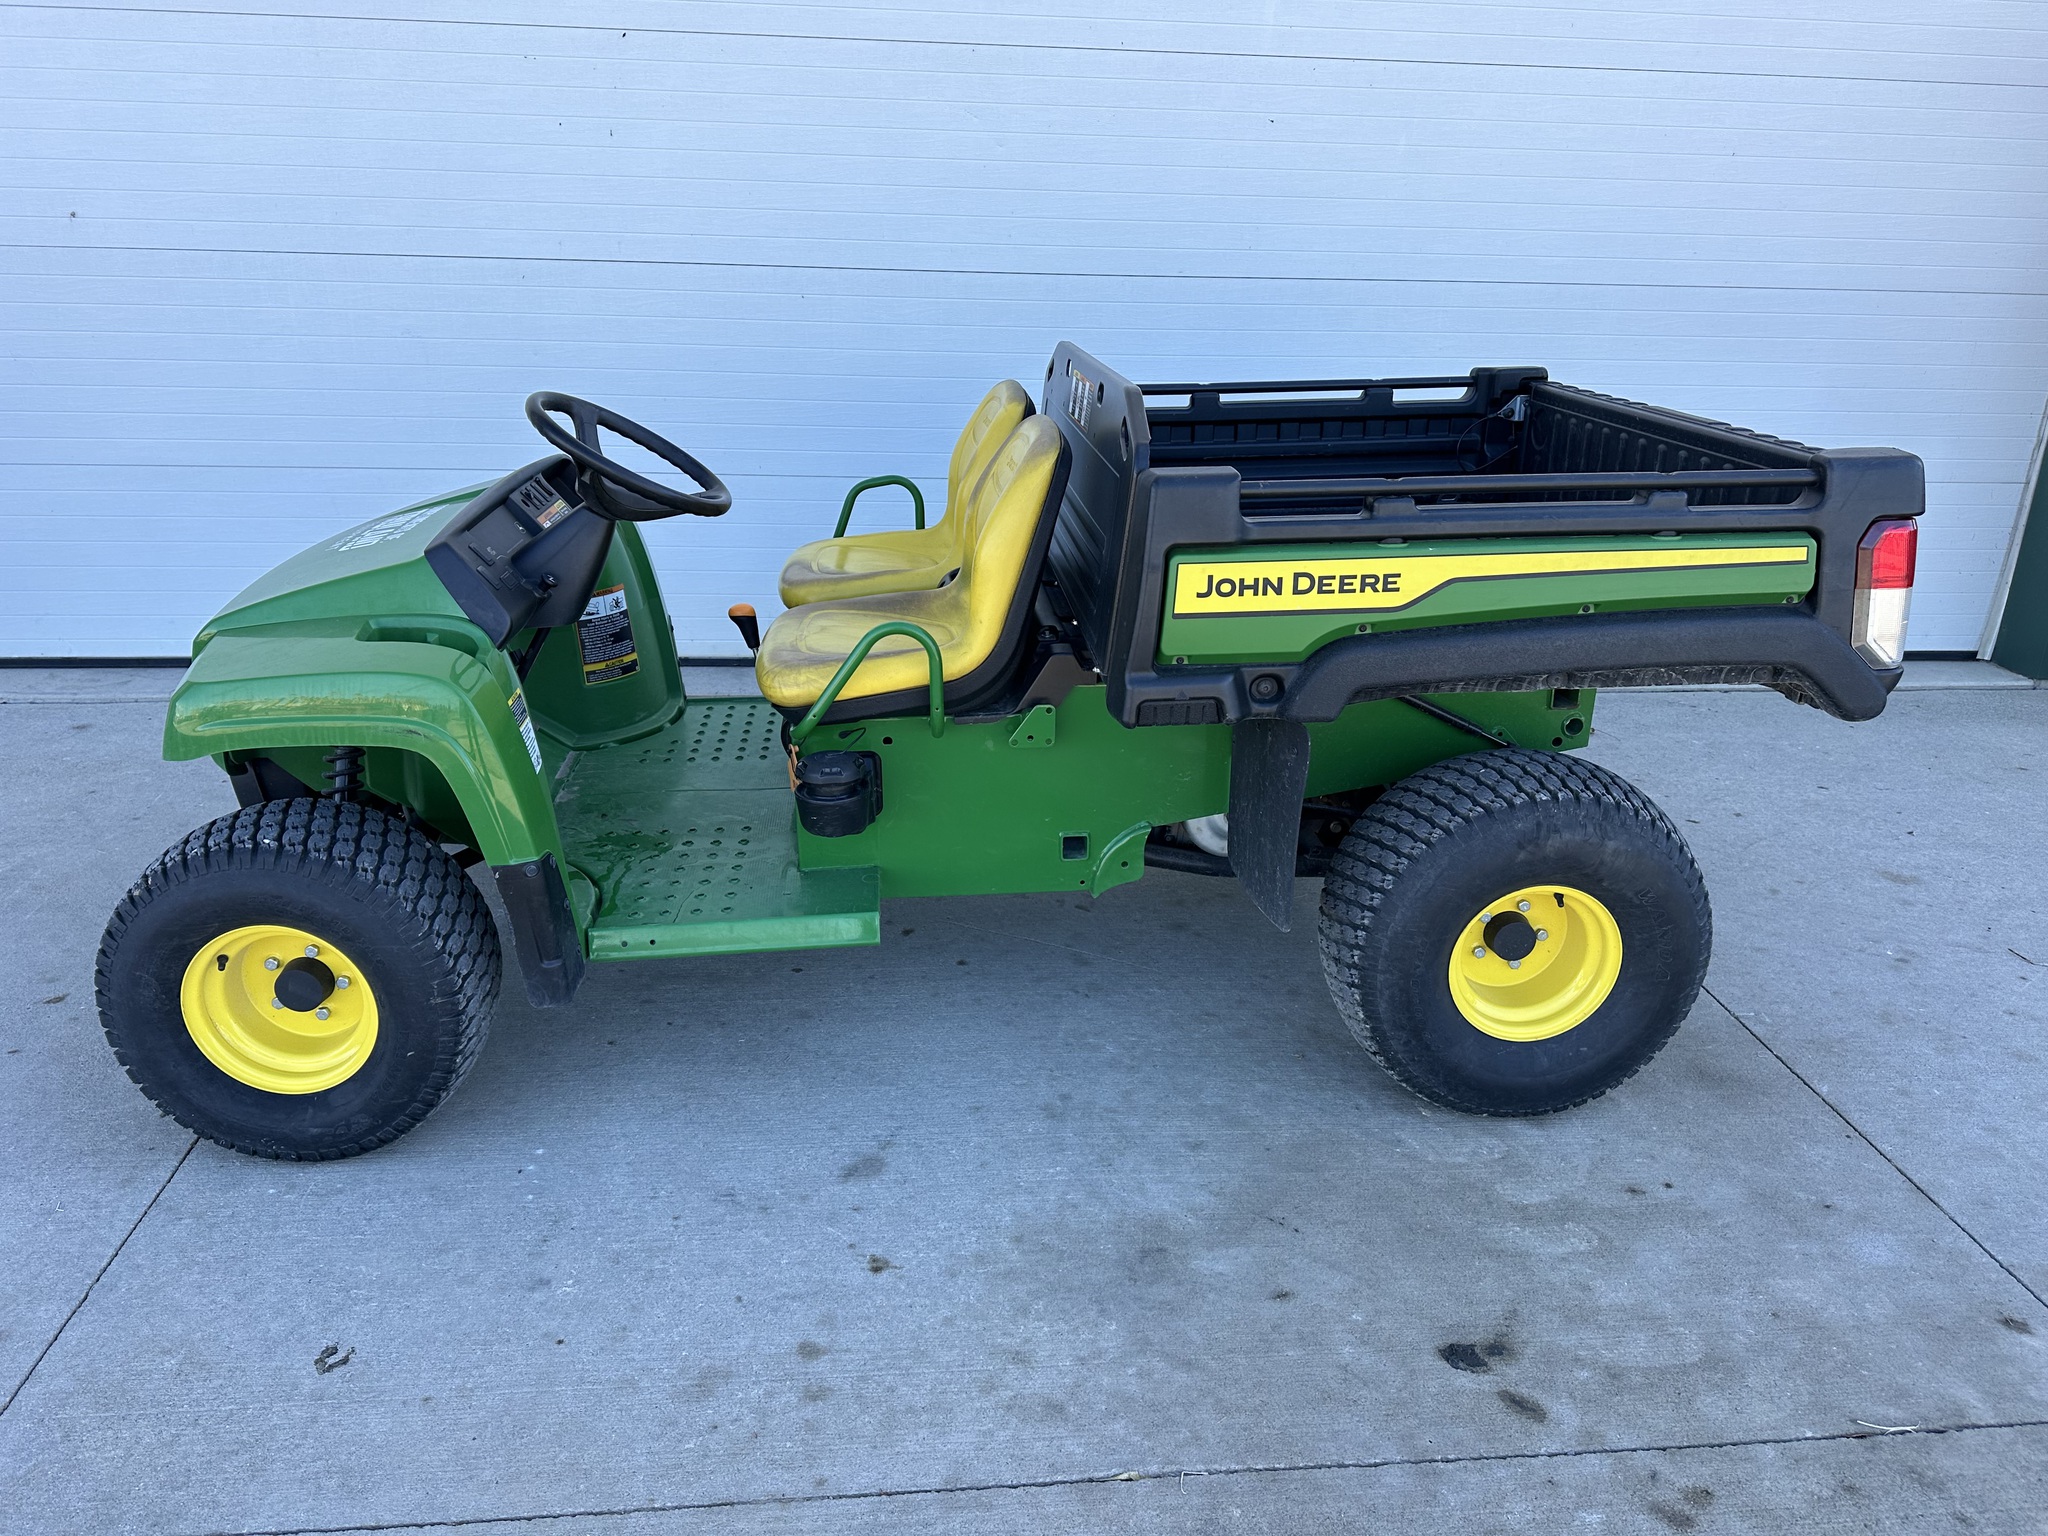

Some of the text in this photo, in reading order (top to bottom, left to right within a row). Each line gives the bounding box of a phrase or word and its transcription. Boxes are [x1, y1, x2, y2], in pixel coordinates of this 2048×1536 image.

[1196, 572, 1402, 598] JOHN DEERE
[1638, 887, 1673, 981] WANDA
